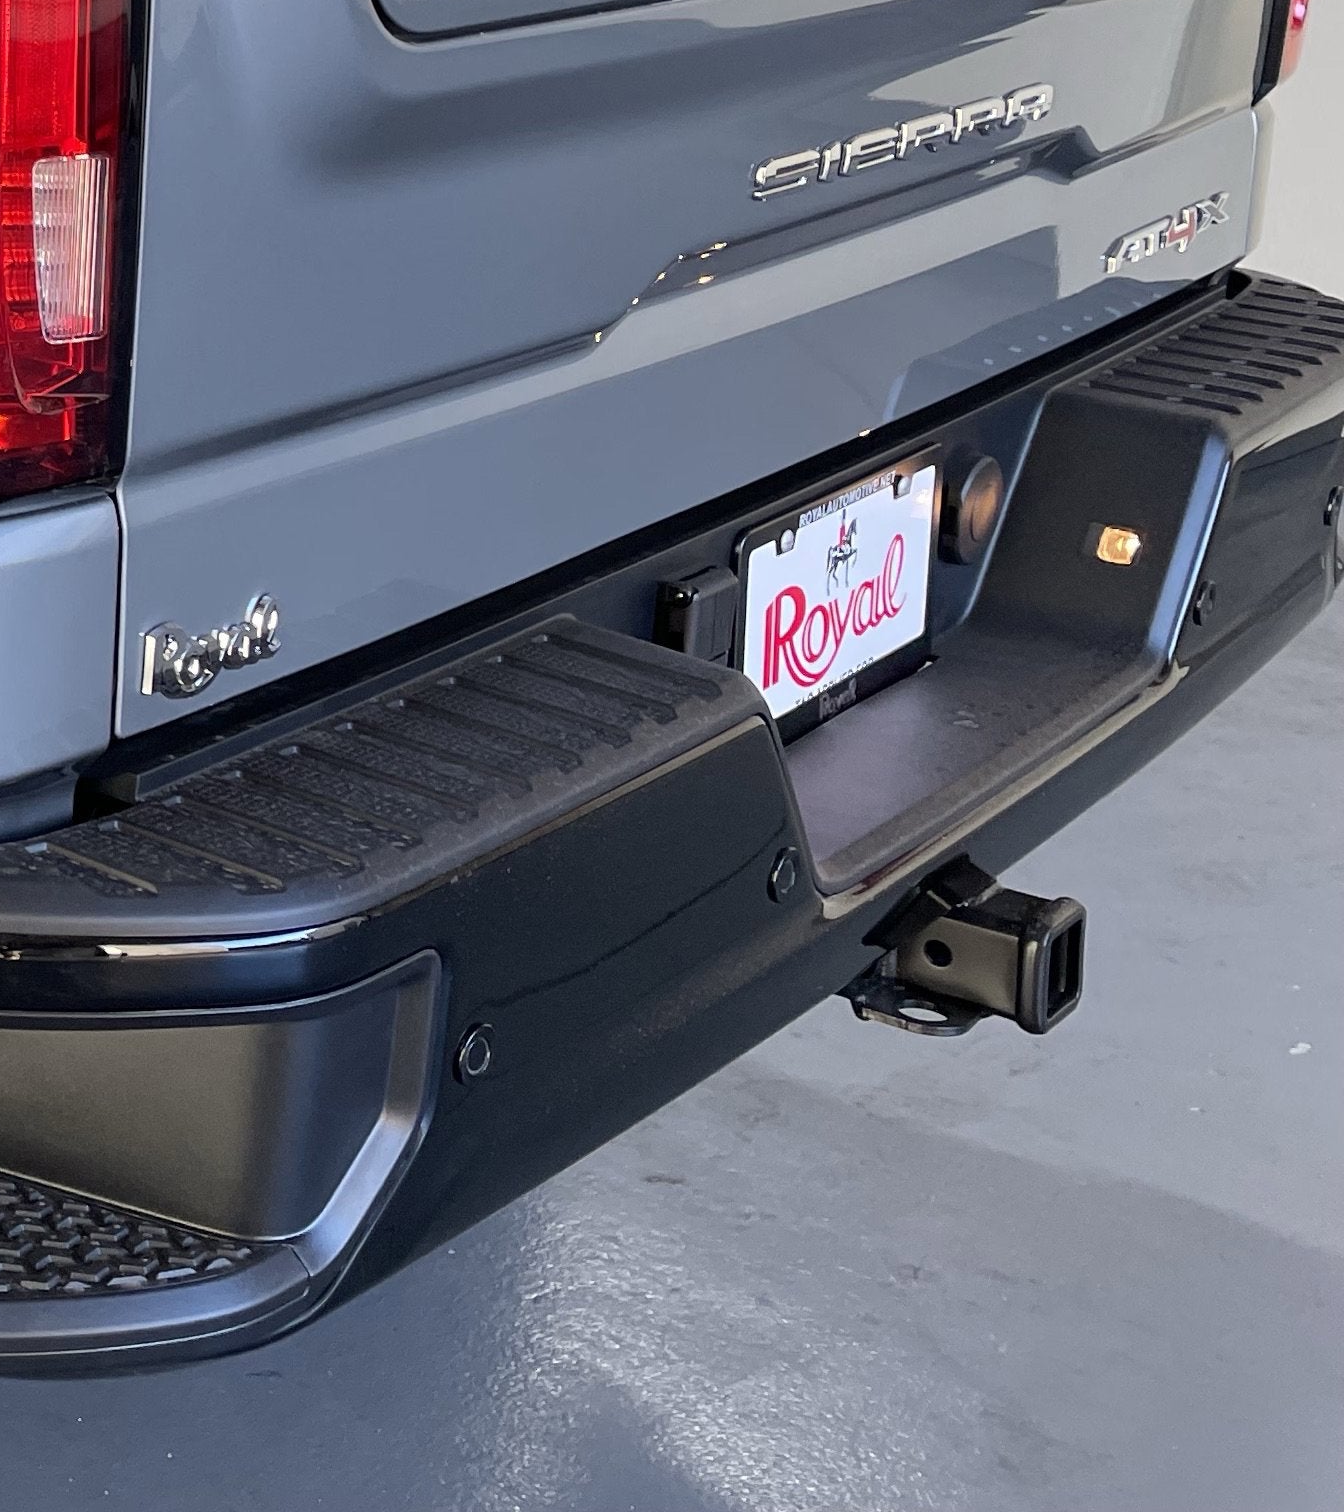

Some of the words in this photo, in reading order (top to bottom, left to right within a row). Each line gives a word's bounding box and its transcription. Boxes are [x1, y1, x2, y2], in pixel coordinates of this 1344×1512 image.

[752, 82, 1055, 201] SIERRA
[1100, 190, 1230, 275] AT4X
[763, 533, 907, 691] Royal
